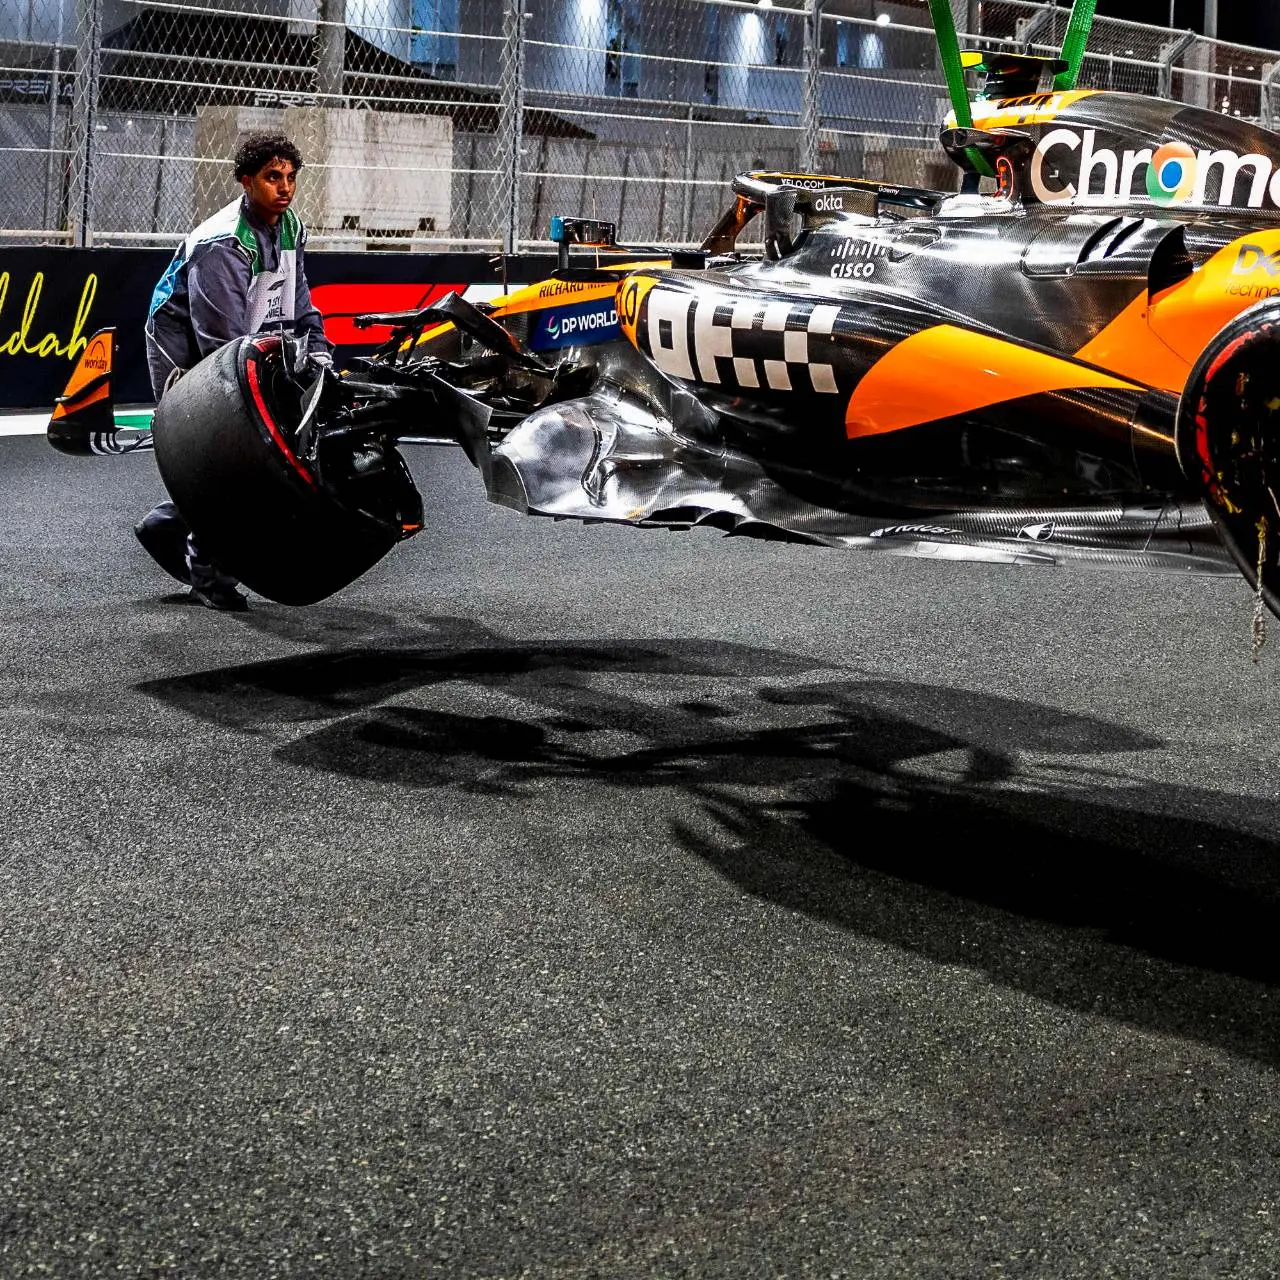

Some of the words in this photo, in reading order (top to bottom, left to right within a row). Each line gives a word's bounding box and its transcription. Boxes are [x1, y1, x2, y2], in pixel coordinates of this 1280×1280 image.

[815, 195, 843, 212] okta
[830, 262, 875, 279] CISCO
[562, 319, 577, 334] DP
[579, 310, 618, 330] WORLD
